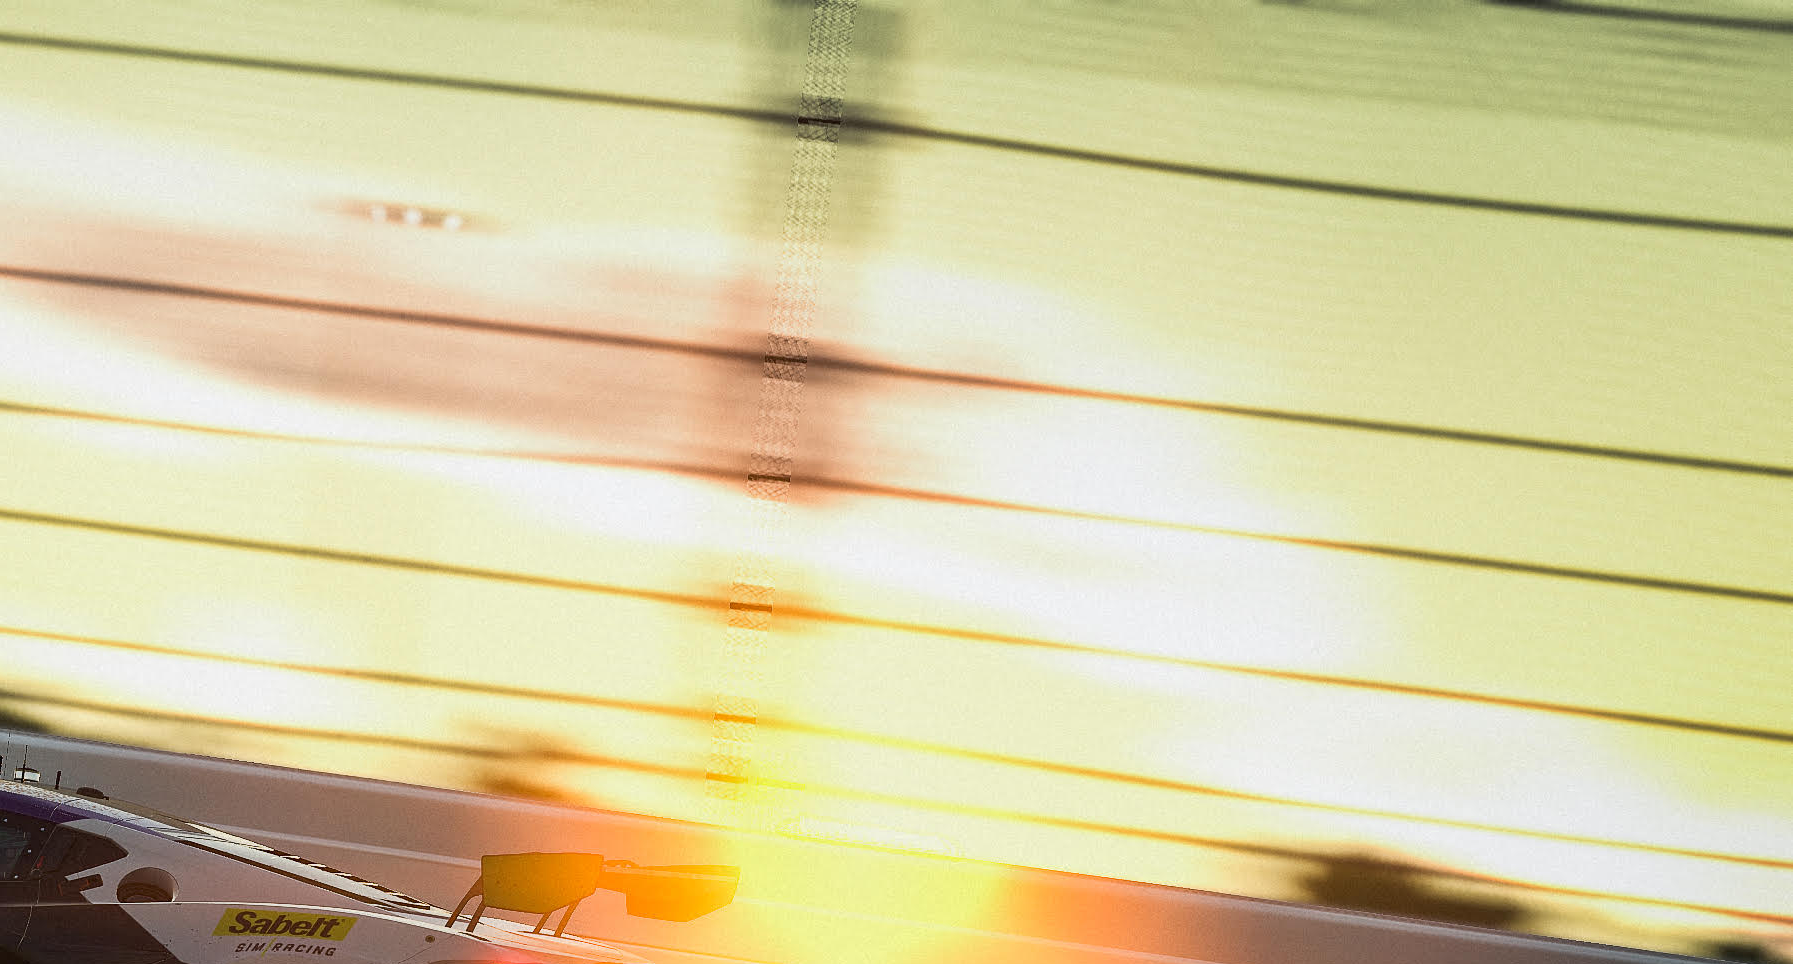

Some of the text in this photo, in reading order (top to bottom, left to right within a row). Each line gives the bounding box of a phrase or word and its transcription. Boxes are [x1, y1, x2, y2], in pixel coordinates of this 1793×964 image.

[228, 910, 340, 938] Sabelt
[235, 942, 337, 957] SIM RACING
